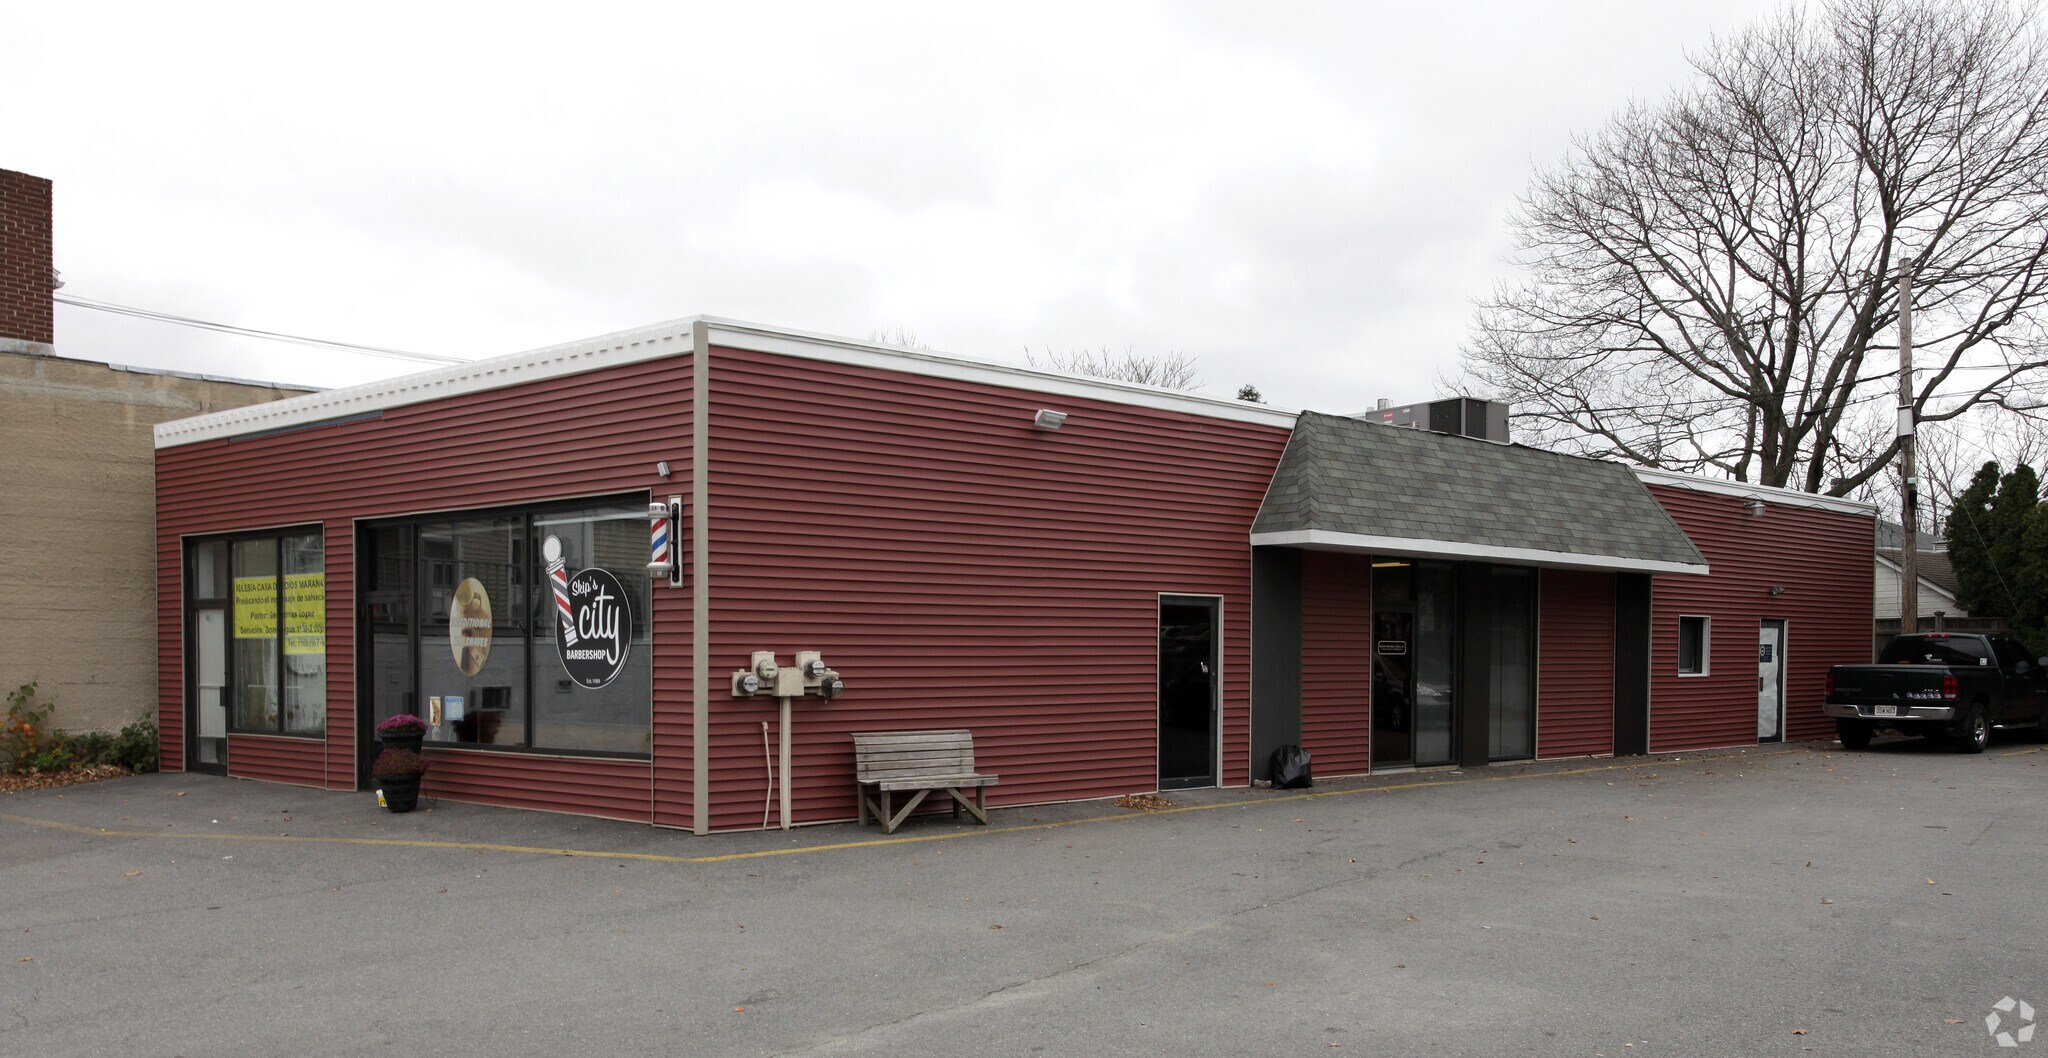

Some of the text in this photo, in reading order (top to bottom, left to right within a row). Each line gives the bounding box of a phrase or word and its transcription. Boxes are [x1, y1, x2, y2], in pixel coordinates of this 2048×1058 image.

[236, 583, 256, 592] IGLESIA
[257, 582, 272, 591] CASA
[572, 576, 598, 597] Skip's
[297, 594, 303, 602] de
[579, 584, 619, 666] city
[465, 637, 488, 648] SHAVES
[566, 649, 606, 660] BARBERSHOP
